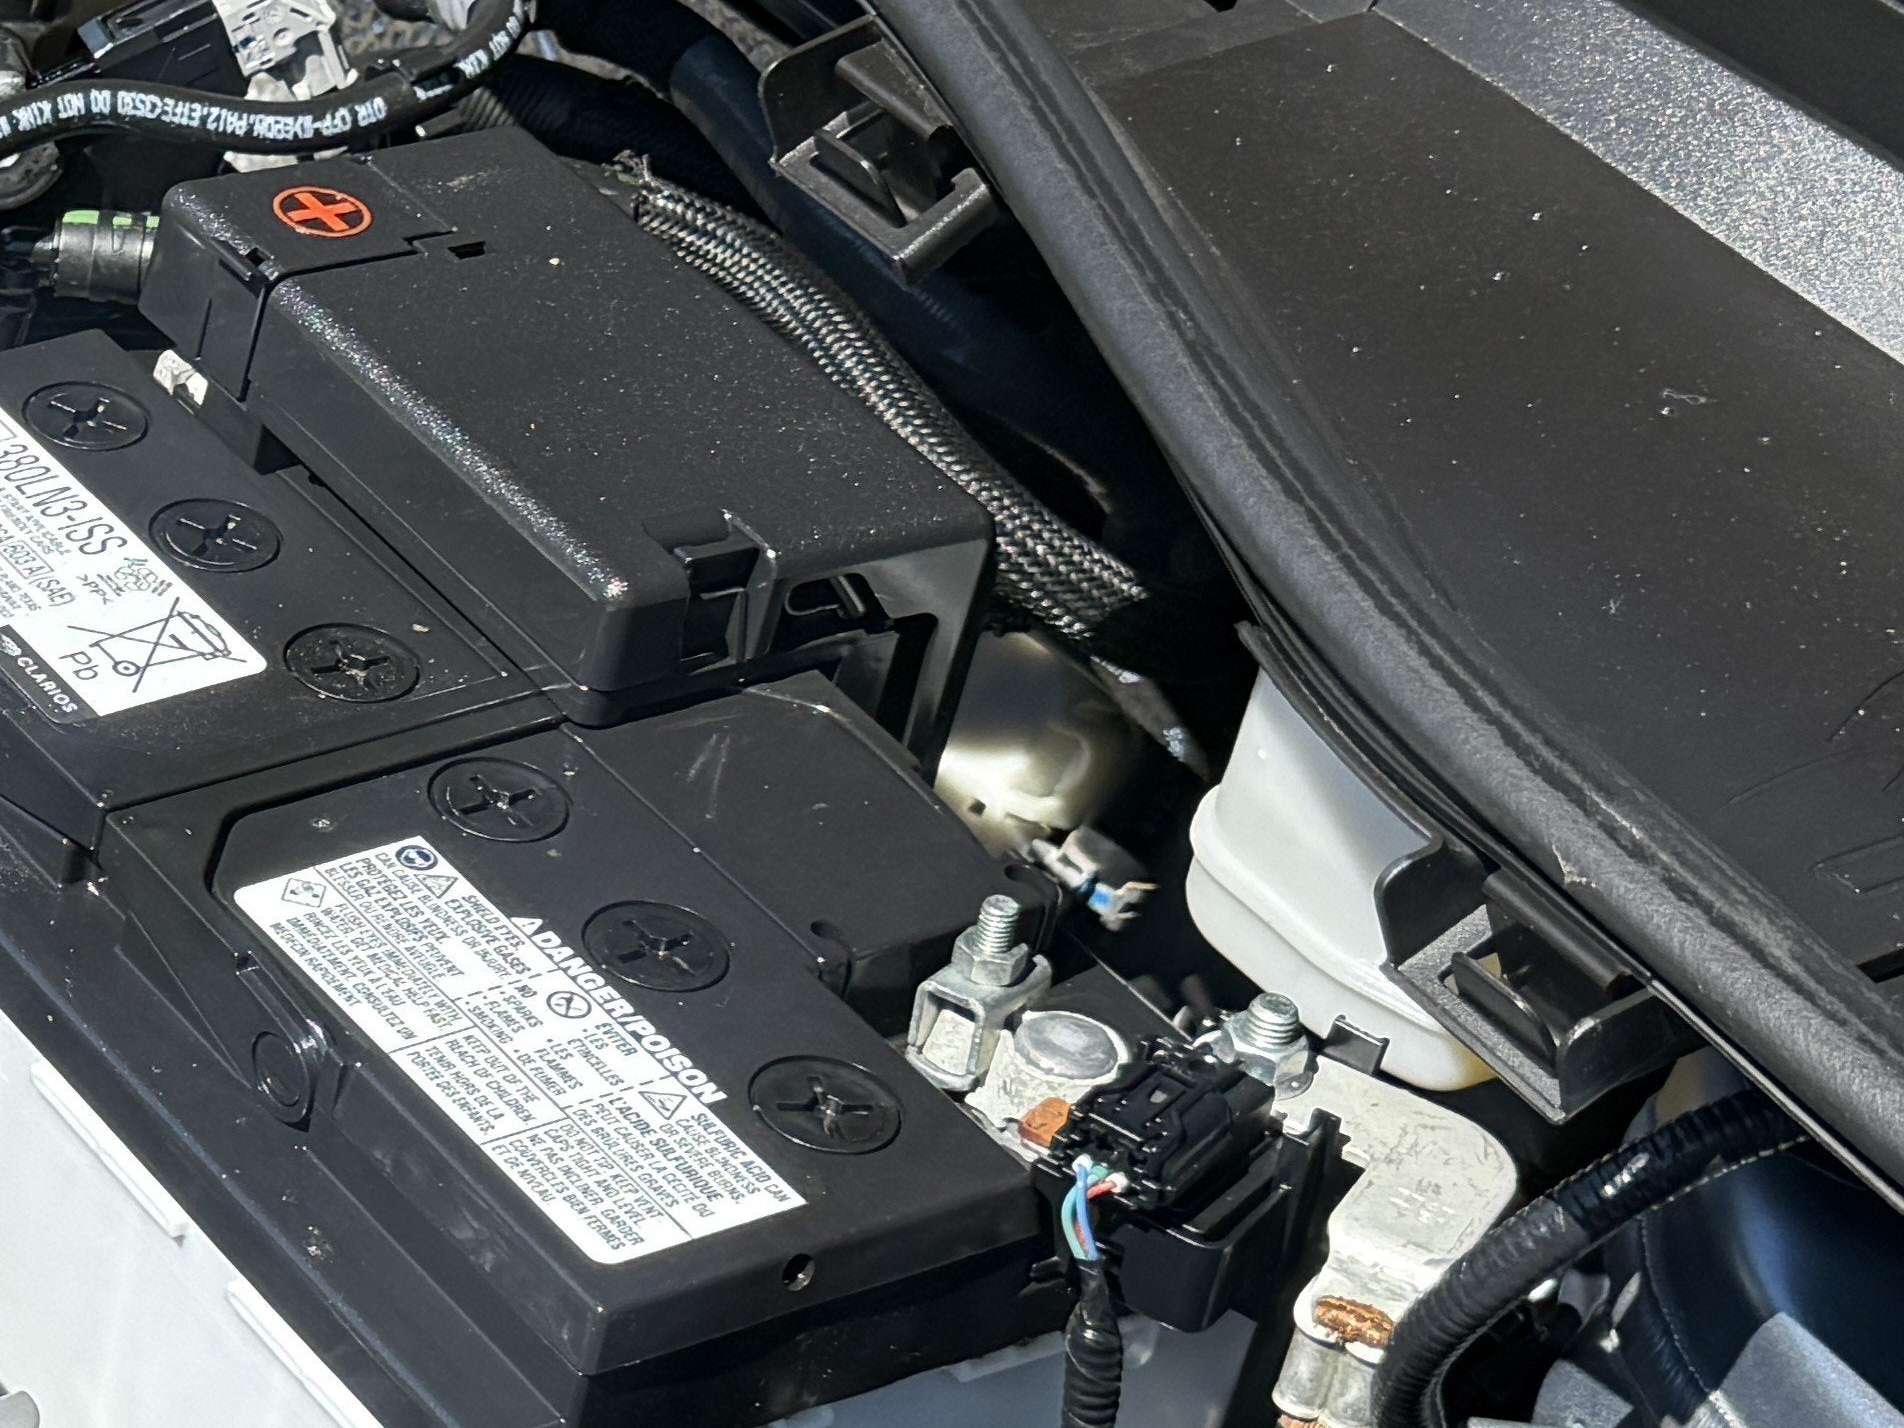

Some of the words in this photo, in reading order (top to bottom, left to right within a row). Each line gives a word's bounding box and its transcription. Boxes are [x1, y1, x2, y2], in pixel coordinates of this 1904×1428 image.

[56, 92, 85, 118] NOT
[25, 574, 80, 608] (SAE)
[56, 649, 108, 682] Pb
[11, 654, 82, 713] CLARIOS
[336, 861, 364, 879] LES
[354, 878, 383, 897] GAZ
[398, 900, 426, 918] LES
[442, 897, 501, 945] EXPLOSIVE
[490, 943, 533, 975] GASES
[512, 983, 539, 999] NO
[483, 999, 527, 1034] FLAMES
[528, 930, 730, 1104] DANGER/POISON
[547, 1042, 575, 1060] LES
[582, 1032, 610, 1050] LES
[514, 1052, 537, 1066] DE
[484, 1107, 507, 1120] LA
[570, 1107, 599, 1127] DES
[672, 1117, 712, 1146] CAUSE
[588, 1102, 621, 1125] PEUT
[611, 1125, 657, 1161] CAUSER
[646, 1159, 671, 1173] LA
[690, 1202, 716, 1218] OU
[605, 1096, 659, 1138] L'ACIDE
[646, 1136, 726, 1202] SULFURIQUE
[688, 1112, 749, 1160] SULFURIC
[737, 1158, 774, 1183] ACID
[761, 1182, 793, 1203] CAN
